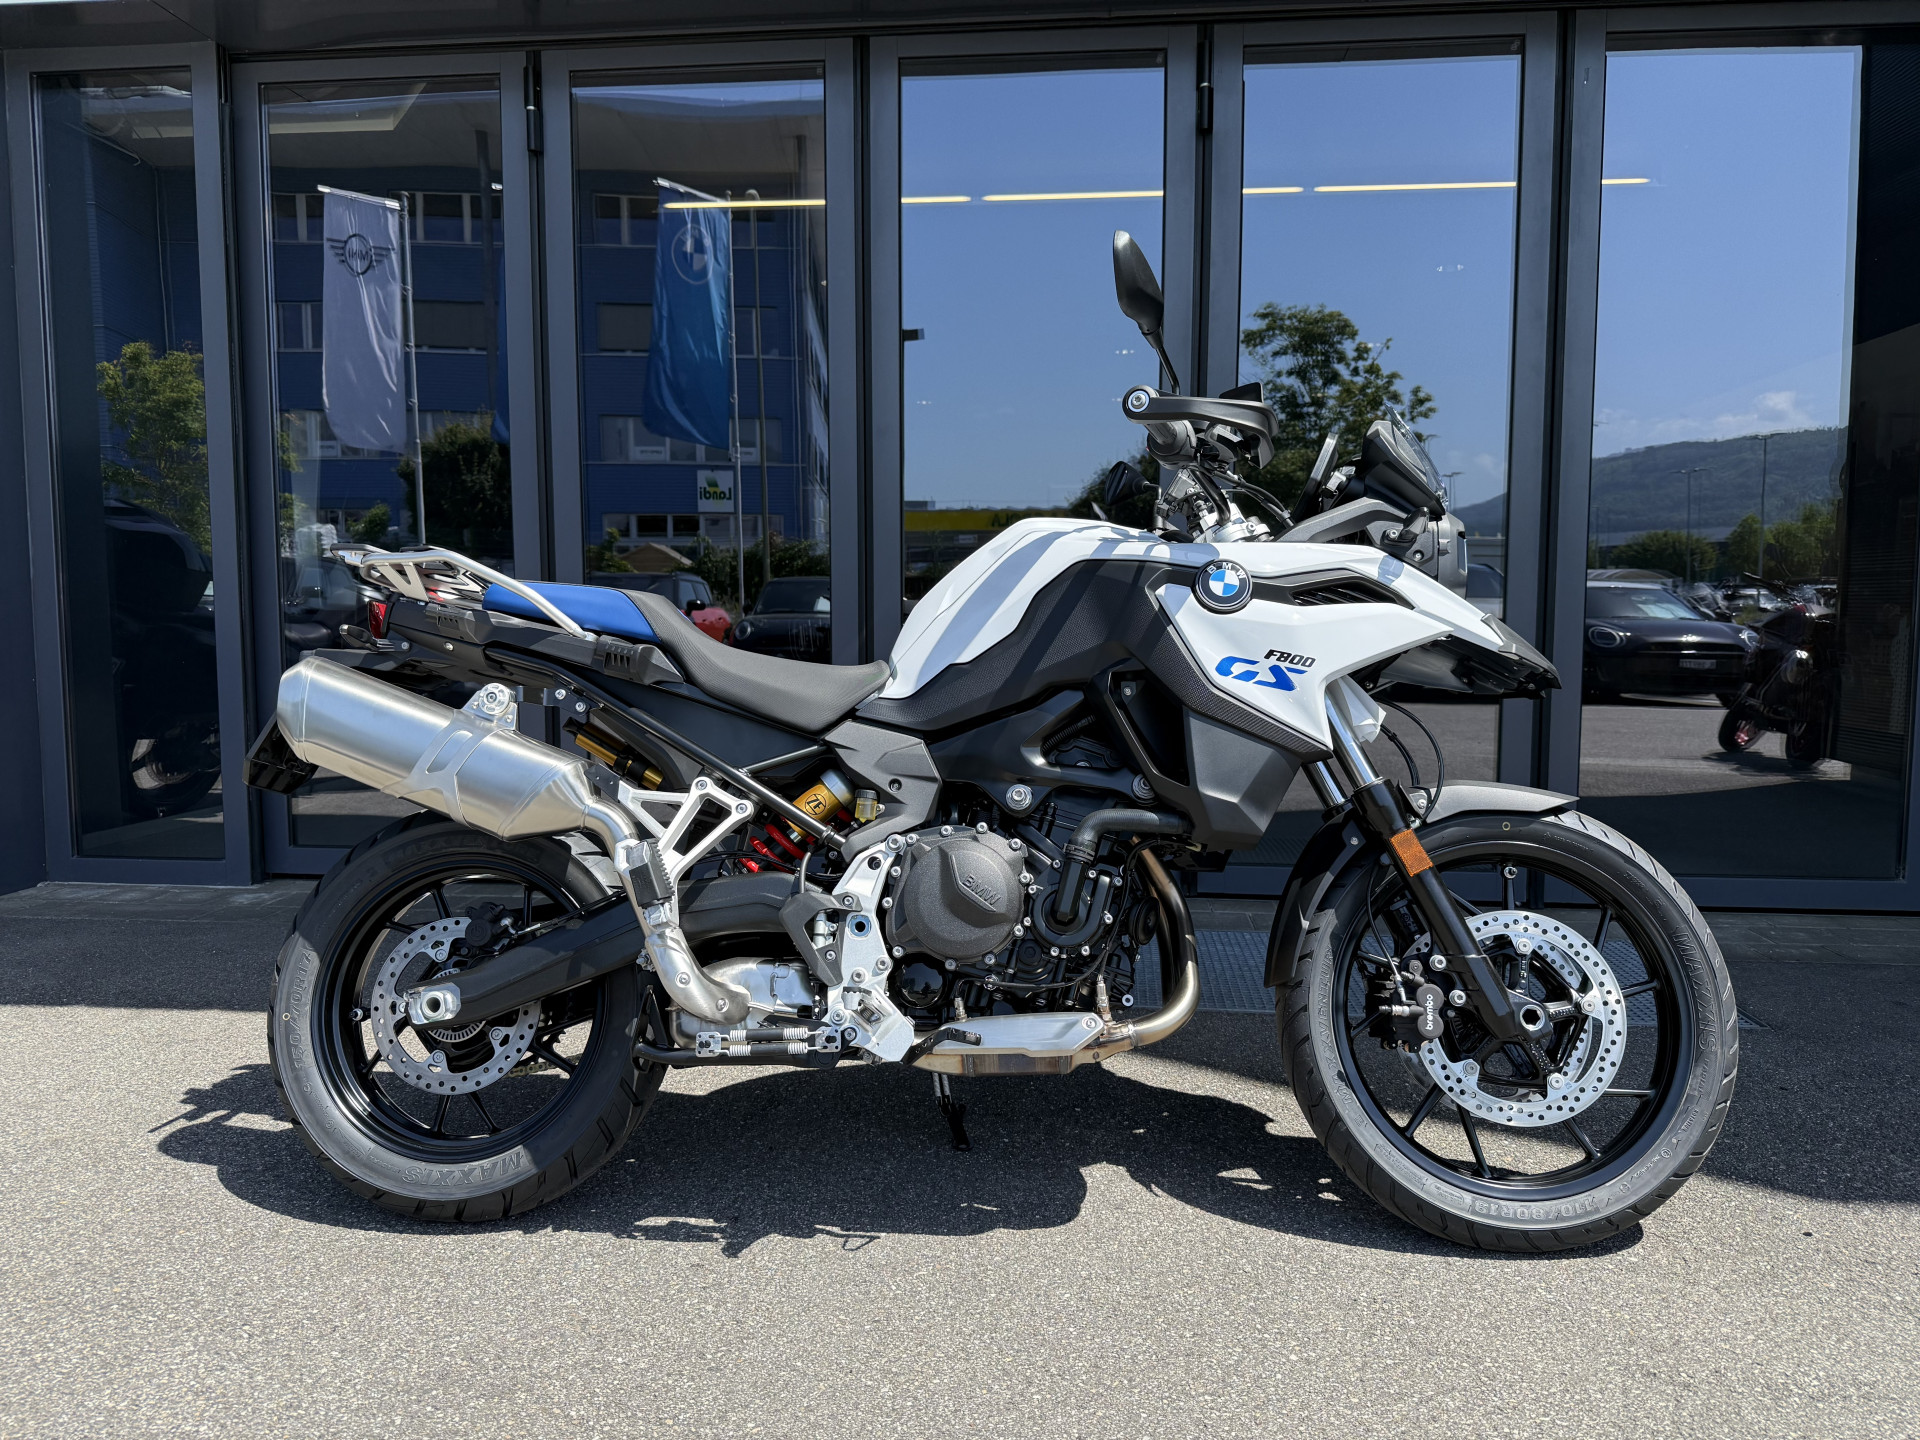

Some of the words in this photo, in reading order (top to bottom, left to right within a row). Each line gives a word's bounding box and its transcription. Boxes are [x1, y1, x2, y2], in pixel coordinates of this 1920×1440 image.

[1207, 562, 1246, 578] BMW
[1215, 656, 1308, 692] GS
[1264, 649, 1316, 668] F800
[805, 793, 826, 815] ZF
[962, 873, 1002, 906] BMW
[1673, 931, 1717, 1052] MAXXIS
[1425, 994, 1434, 1030] brembo
[402, 1151, 523, 1187] MAXXIS
